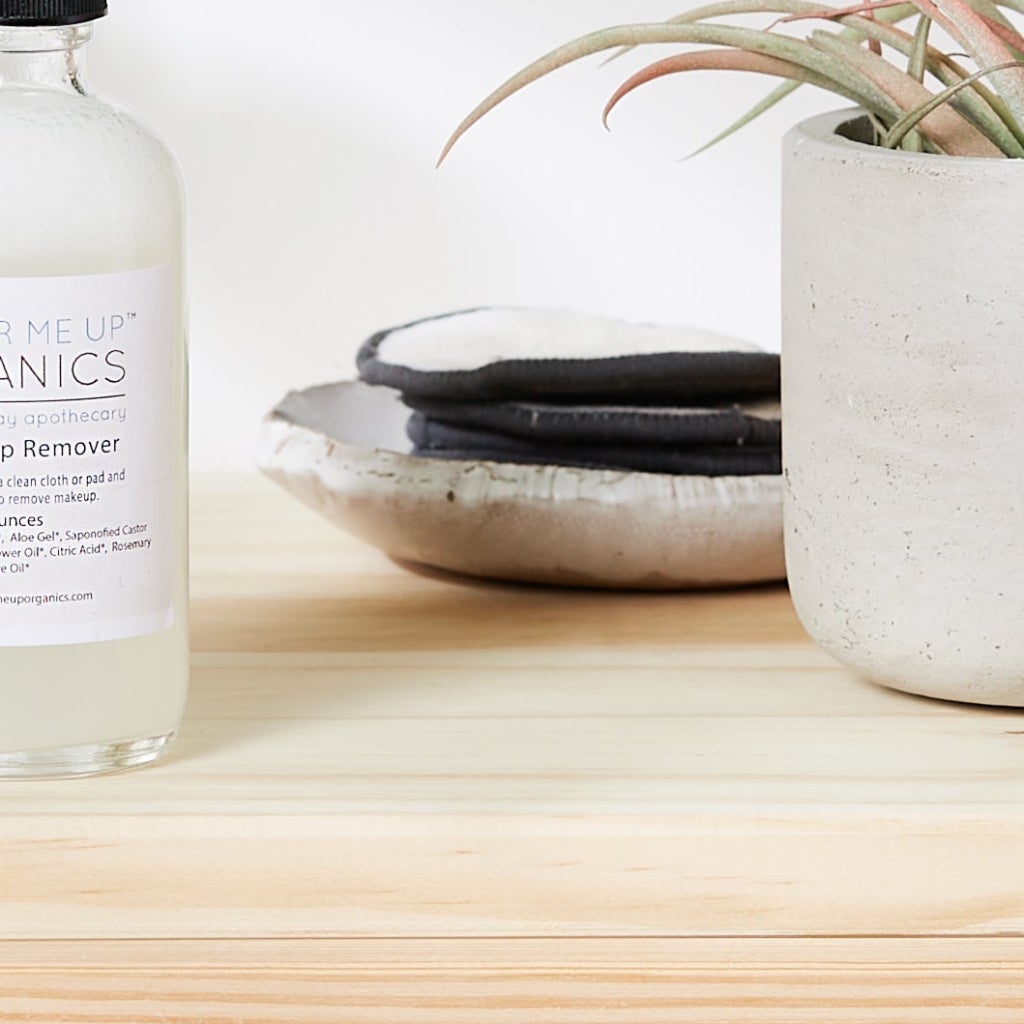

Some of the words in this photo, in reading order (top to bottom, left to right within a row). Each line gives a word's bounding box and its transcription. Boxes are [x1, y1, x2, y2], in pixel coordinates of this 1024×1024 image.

[27, 318, 72, 345] ME
[24, 407, 127, 428] apothecary
[24, 437, 120, 458] Remover
[7, 475, 37, 487] clean
[40, 474, 69, 487] cloth
[71, 476, 83, 485] or
[86, 471, 105, 487] pad
[107, 468, 126, 482] and
[8, 494, 50, 505] remove
[54, 491, 100, 504] makeup.
[10, 532, 35, 543] Aloe
[122, 524, 147, 536] Castor
[49, 546, 77, 557] Citric
[112, 538, 152, 552] Rosemary
